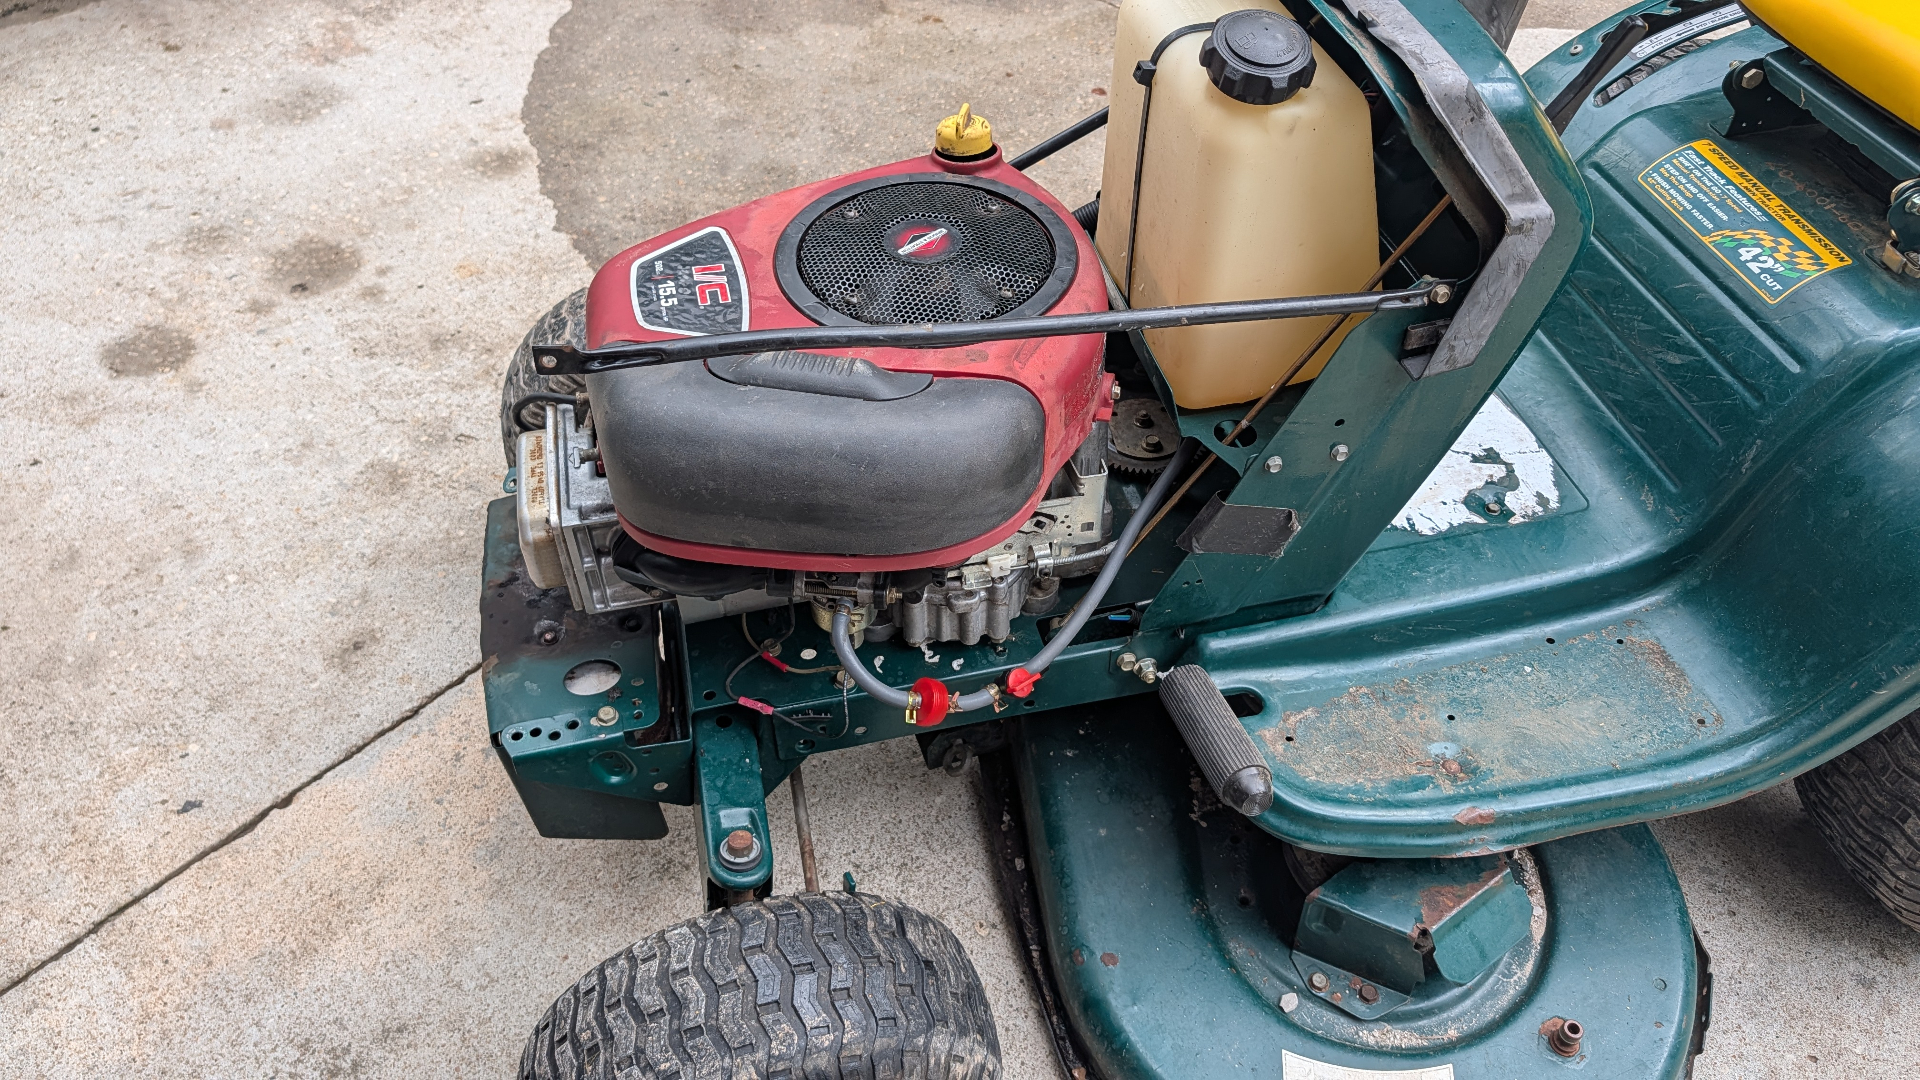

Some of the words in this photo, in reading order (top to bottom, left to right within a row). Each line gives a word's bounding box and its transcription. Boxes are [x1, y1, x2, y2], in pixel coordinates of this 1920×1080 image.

[1650, 172, 1671, 190] FINISH
[1669, 188, 1693, 210] MOWING
[1664, 163, 1679, 176] STEP
[1677, 175, 1687, 184] ON
[1685, 183, 1699, 194] AND
[1696, 193, 1710, 203] OFF
[1677, 156, 1695, 169] SHIFT
[1692, 169, 1703, 177] ON
[1701, 176, 1714, 187] THE
[1711, 186, 1721, 194] GO
[1703, 165, 1727, 185] Track
[1725, 185, 1763, 217] Features
[1708, 147, 1740, 171] SPEED
[1736, 170, 1776, 202] MANUAL
[1775, 203, 1849, 263] TRANSMISSION
[1738, 182, 1757, 197] LAWN
[1757, 197, 1787, 222] TRACTOR
[657, 280, 678, 307] 15.5
[1760, 273, 1784, 291] CUT
